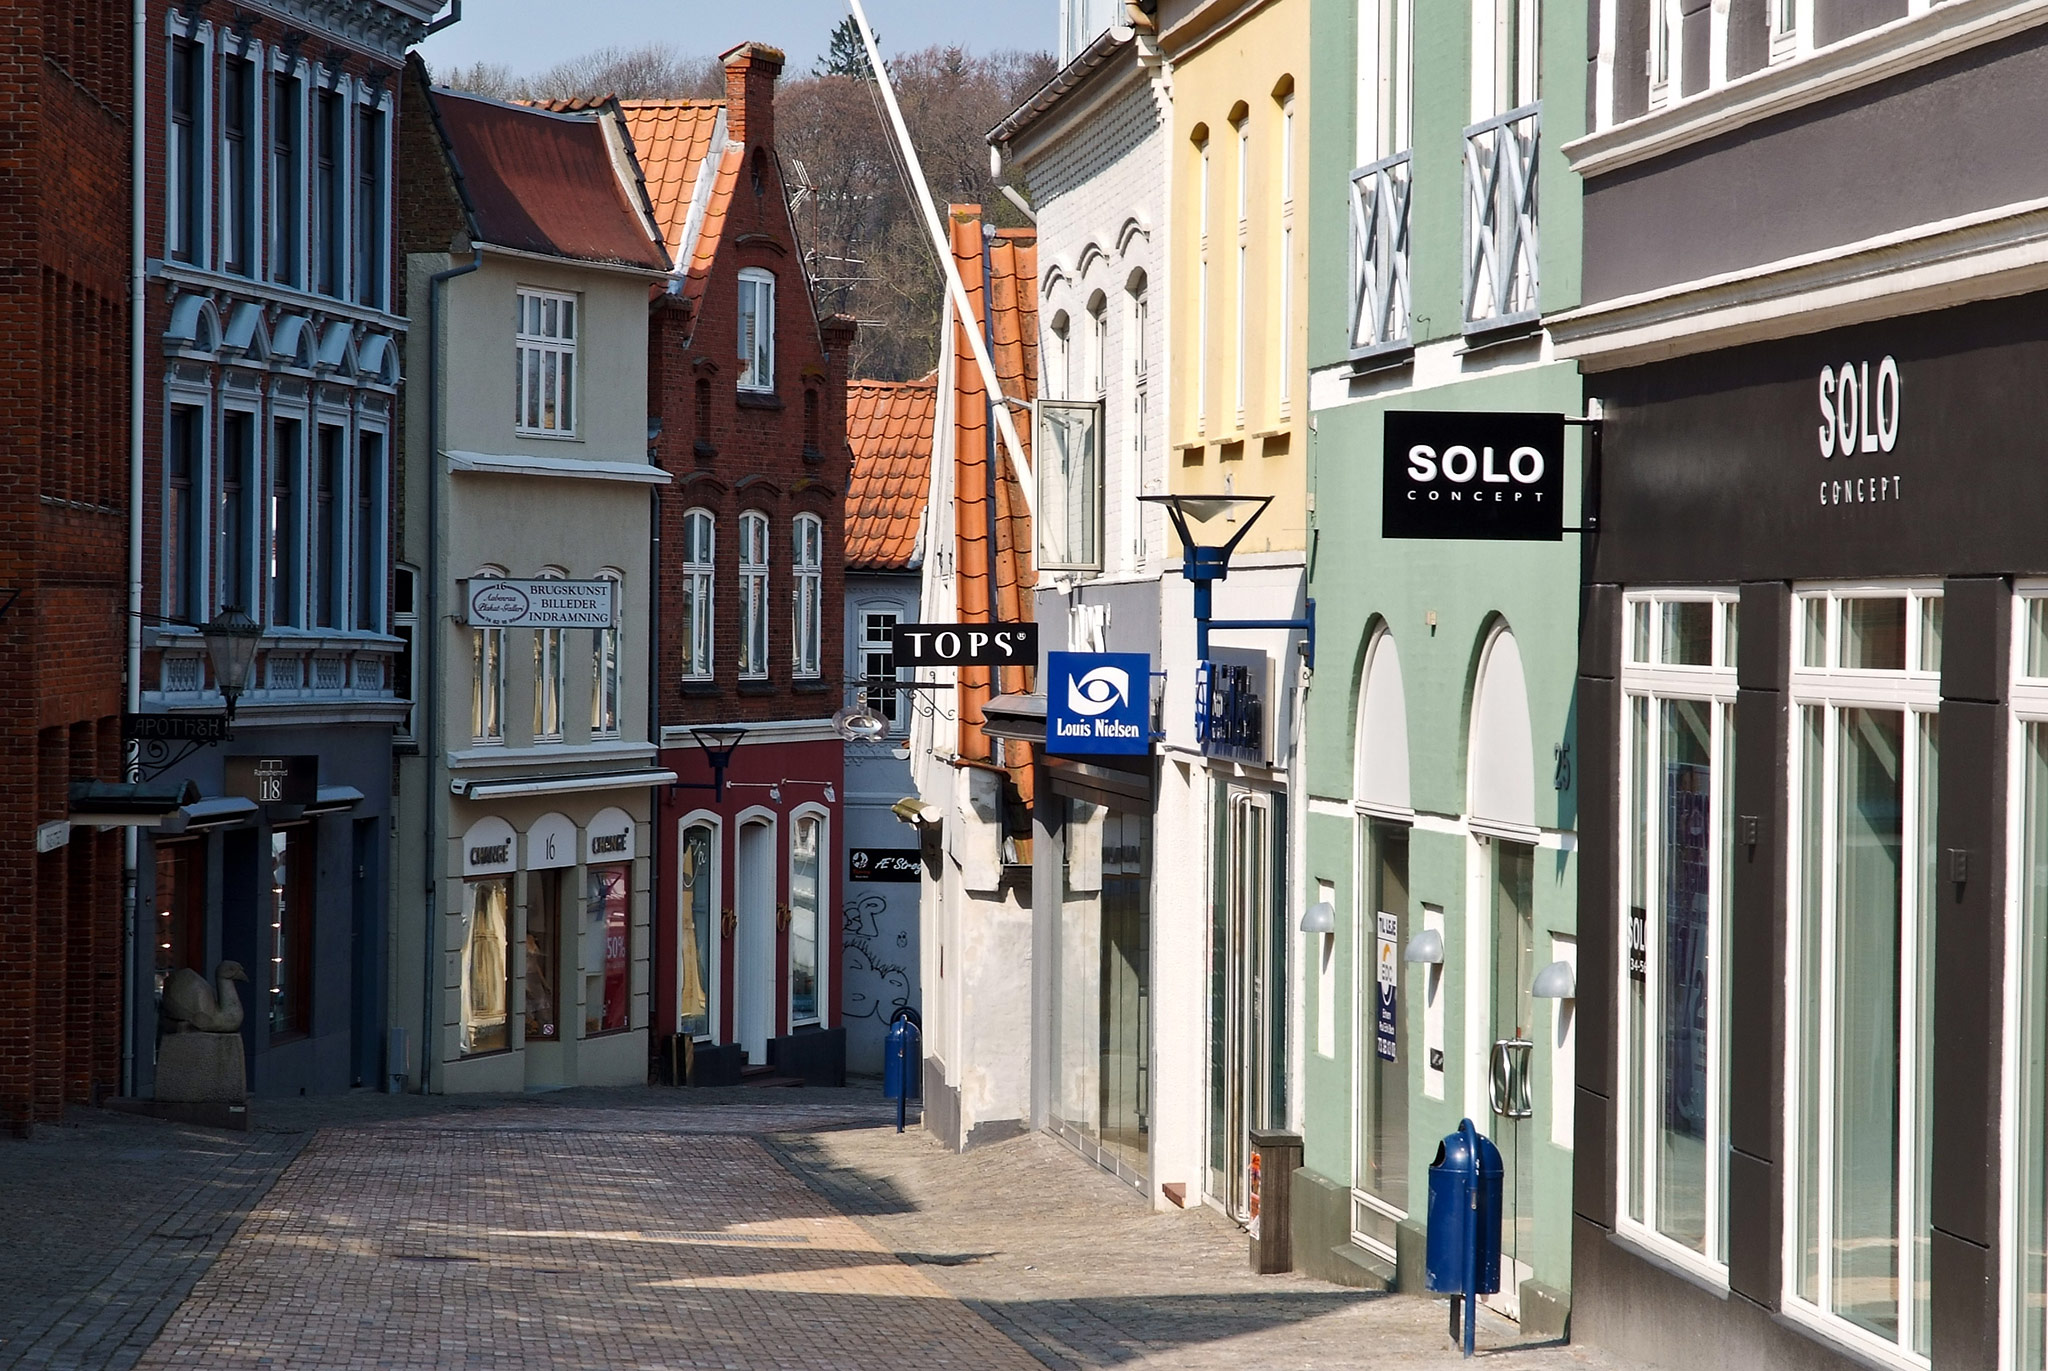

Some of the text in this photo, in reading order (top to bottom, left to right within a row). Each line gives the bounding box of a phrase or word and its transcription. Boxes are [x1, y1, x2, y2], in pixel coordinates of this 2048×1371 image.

[1818, 354, 1900, 460] SOLO
[1407, 443, 1545, 483] SOLO
[1407, 489, 1544, 502] CONCEPT
[1820, 474, 1903, 506] CONCEPT
[530, 585, 608, 596] BRUGSKUNST
[541, 598, 597, 609] BILLEDER
[529, 612, 608, 623] INDRAMNING
[1056, 718, 1140, 738] Louis Nielsen
[262, 779, 280, 799] 18
[545, 833, 556, 861] 16
[607, 936, 626, 959] 50%
